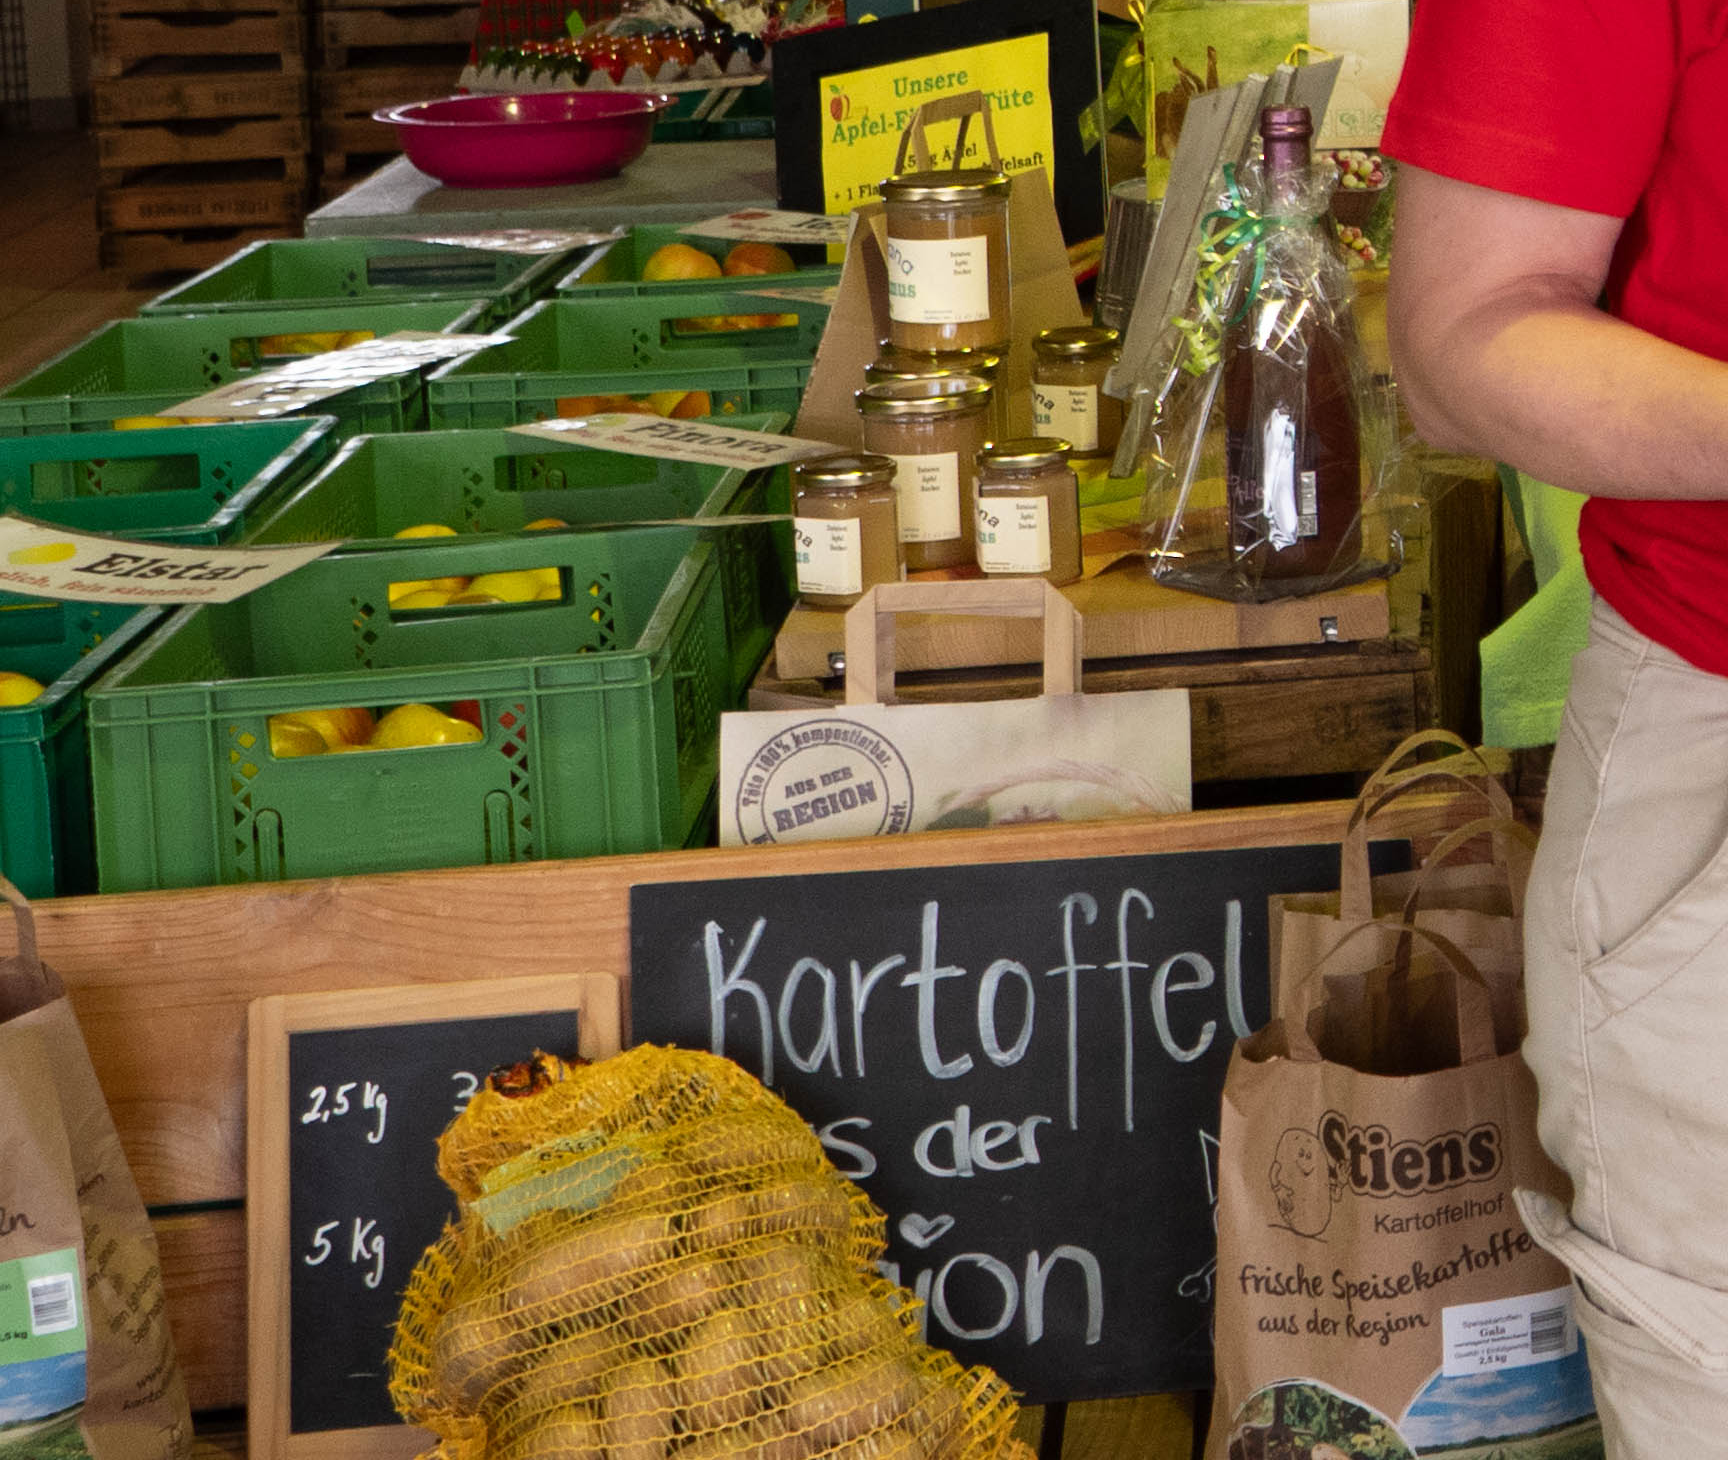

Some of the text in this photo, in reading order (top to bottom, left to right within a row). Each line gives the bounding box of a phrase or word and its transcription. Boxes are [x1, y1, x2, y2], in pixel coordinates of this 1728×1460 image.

[893, 70, 969, 99] Unsere
[72, 552, 271, 581] Elstar
[755, 738, 793, 773] 100%
[790, 726, 893, 769] kompostierbar.
[784, 765, 854, 799] AUS DER
[772, 779, 878, 833] REGION
[301, 1082, 358, 1125] 2,5
[913, 1104, 1052, 1178] der
[1322, 1114, 1499, 1193] Stiens
[1373, 1192, 1506, 1235] Kartoffelhof
[305, 1216, 387, 1289] 5 Kg
[1239, 1263, 1324, 1300] frische
[1257, 1310, 1430, 1347] aus der Region
[1479, 1325, 1507, 1338] Gala
